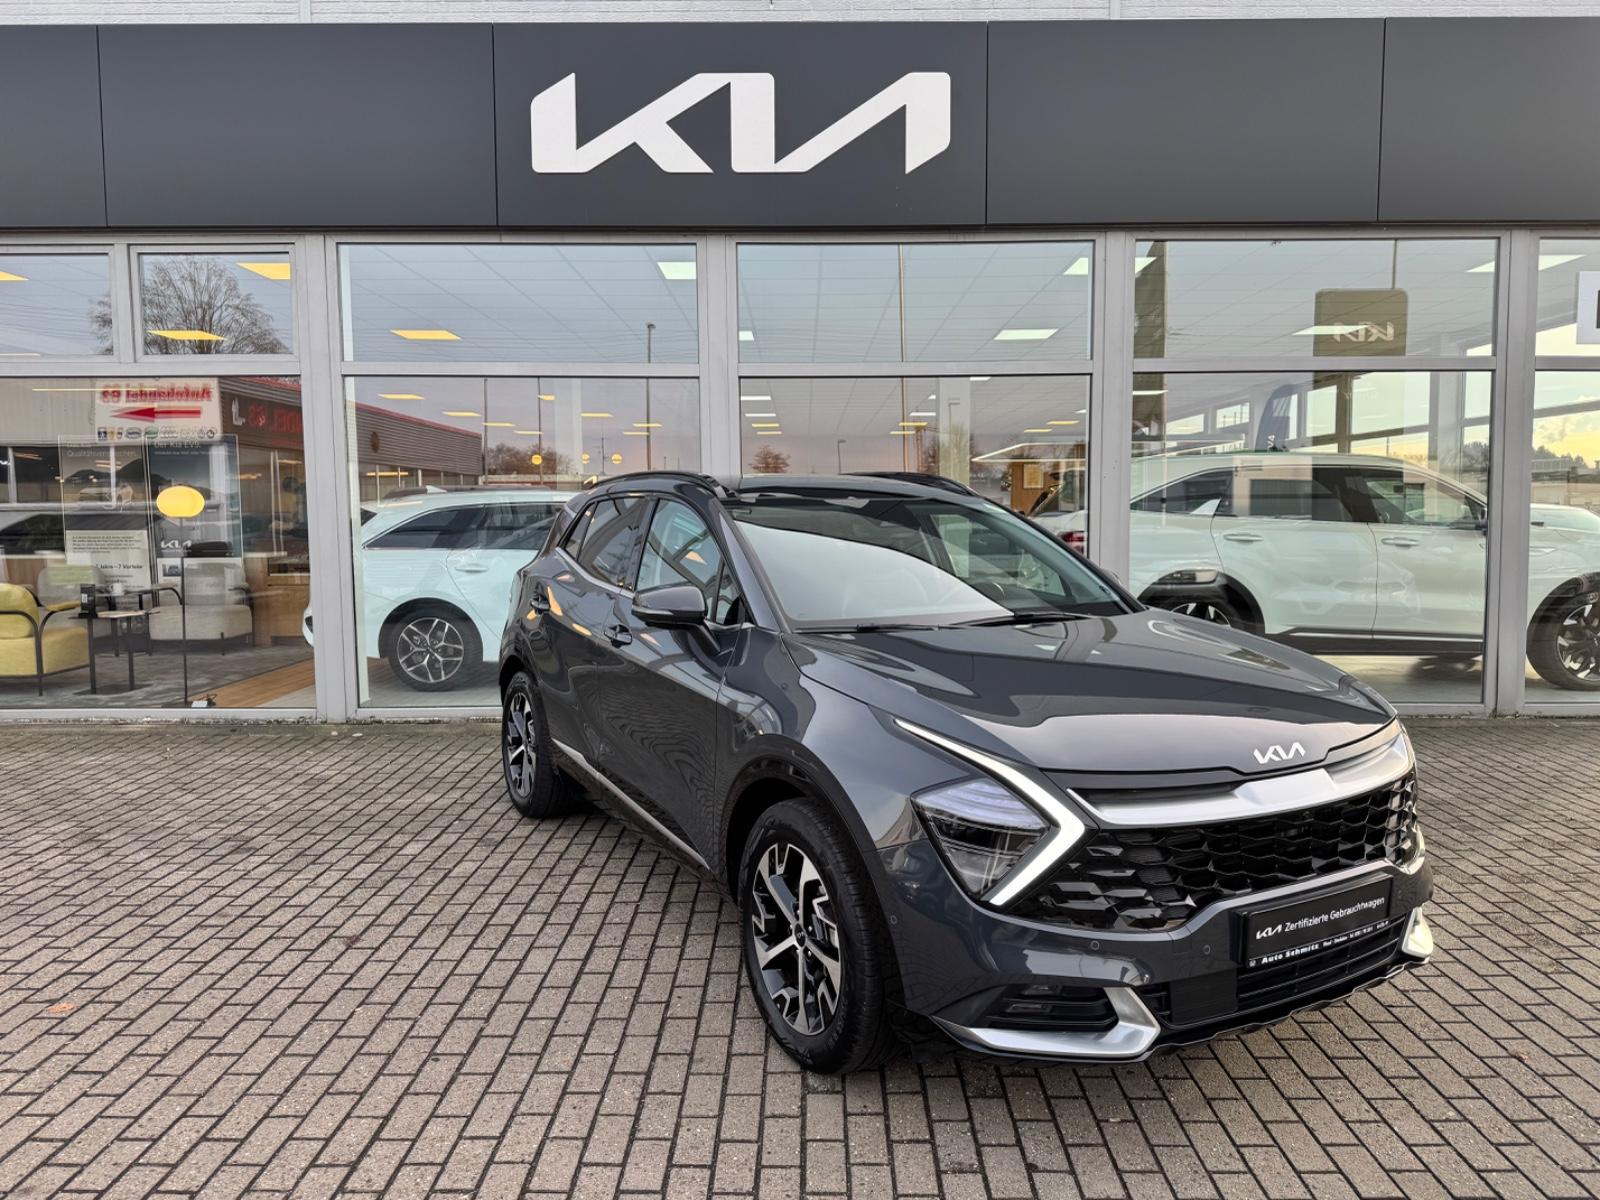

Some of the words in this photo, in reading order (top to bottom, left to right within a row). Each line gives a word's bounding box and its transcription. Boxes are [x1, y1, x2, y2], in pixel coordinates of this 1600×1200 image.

[530, 72, 951, 174] KIA
[1253, 742, 1306, 764] KIA
[1256, 924, 1282, 939] KIA
[1284, 912, 1329, 932] Zertifizierte
[1329, 897, 1385, 920] Gebrauchtwagen
[1261, 953, 1283, 965] Auto
[1285, 943, 1320, 958] Schmitz
